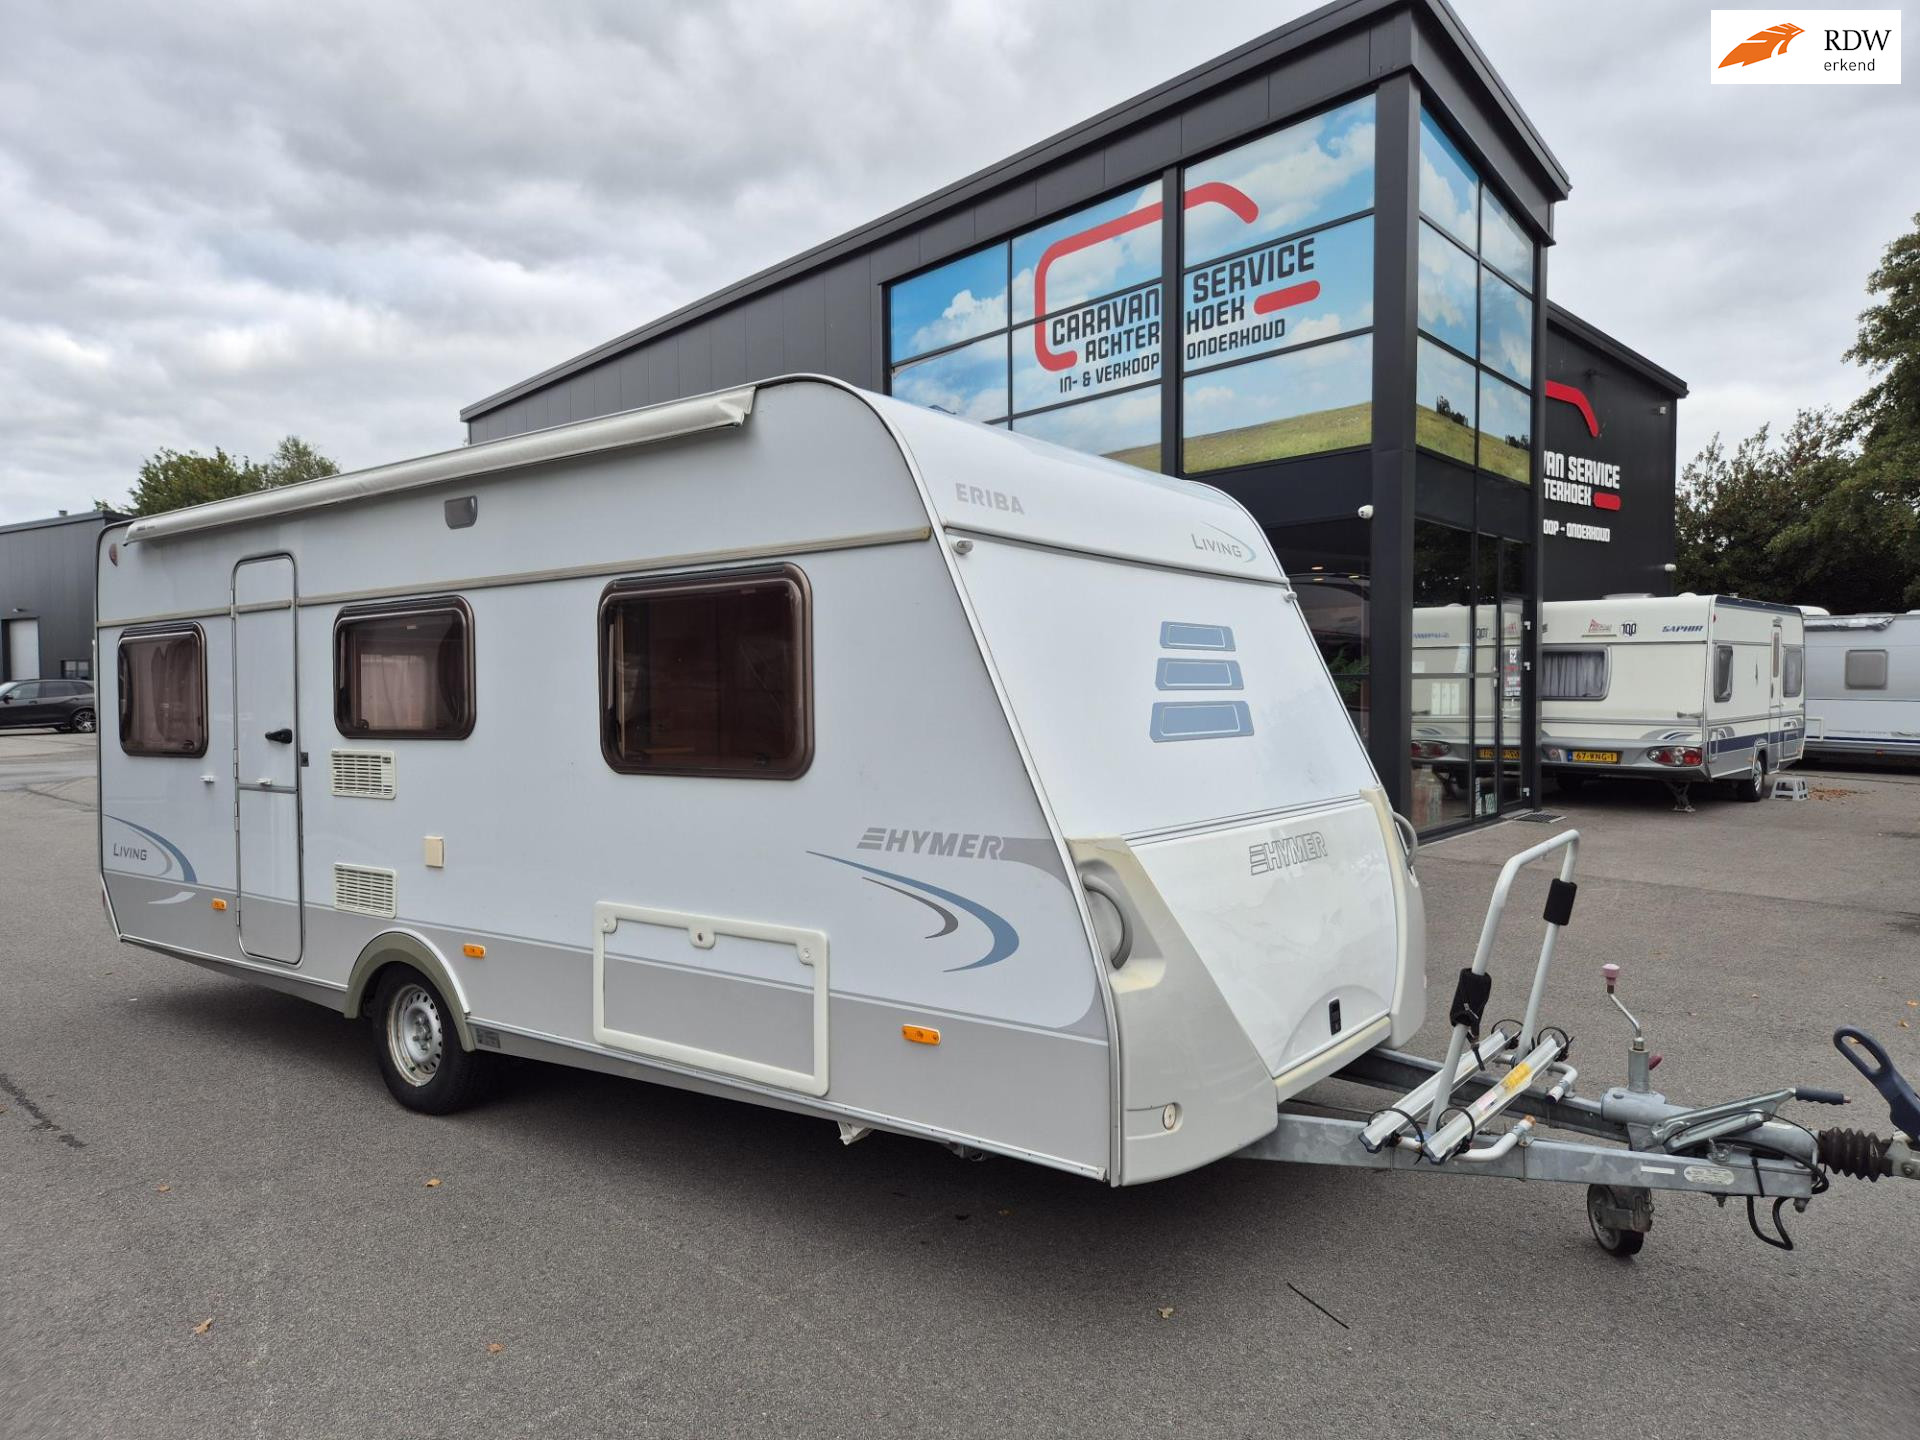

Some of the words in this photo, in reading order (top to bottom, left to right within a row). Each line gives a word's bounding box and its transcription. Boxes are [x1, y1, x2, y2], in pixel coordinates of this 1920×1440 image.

[1052, 288, 1160, 346] CARAVAN
[1193, 238, 1316, 304] SERVICE
[1084, 321, 1160, 363] ACHTER
[1187, 295, 1245, 335] HOEK
[1059, 375, 1078, 393] IN-
[1082, 370, 1092, 387] &
[1096, 353, 1160, 384] VERKOOP
[1187, 319, 1286, 360] ONDERHOUD
[1568, 456, 1620, 489] SERVICE
[955, 482, 1024, 515] ERIBA
[1544, 478, 1592, 506] TERHOEK
[1190, 533, 1242, 559] LIVING
[1566, 522, 1611, 543] ONDERHOUD
[113, 843, 148, 861] LIVING
[884, 829, 1003, 861] HYMER
[1263, 831, 1328, 871] HYMER
